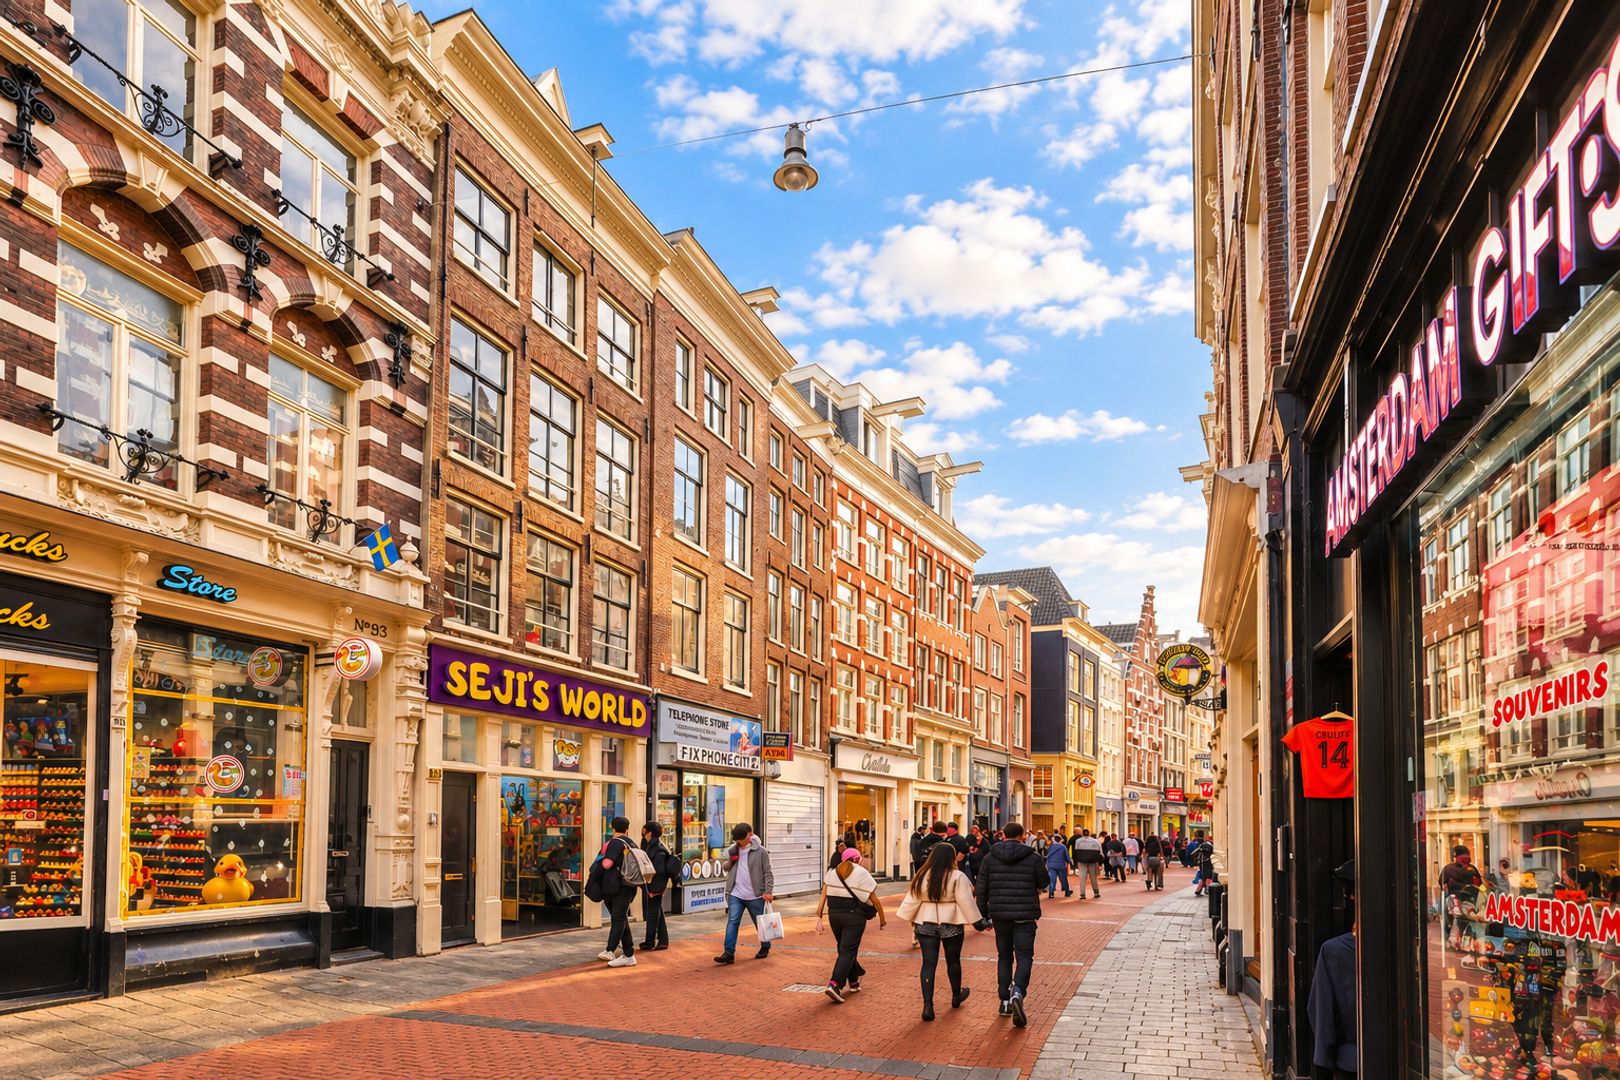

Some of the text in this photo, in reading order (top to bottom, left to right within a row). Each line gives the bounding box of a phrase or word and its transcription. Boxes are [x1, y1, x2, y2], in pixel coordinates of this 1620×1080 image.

[1325, 285, 1462, 558] AMSTERDAM
[164, 565, 236, 601] Store
[446, 661, 647, 728] SEJI'S WORLD
[1492, 661, 1608, 728] SOUVENIRS
[1317, 741, 1350, 768] 14
[1486, 893, 1620, 944] AMSTERDAM
